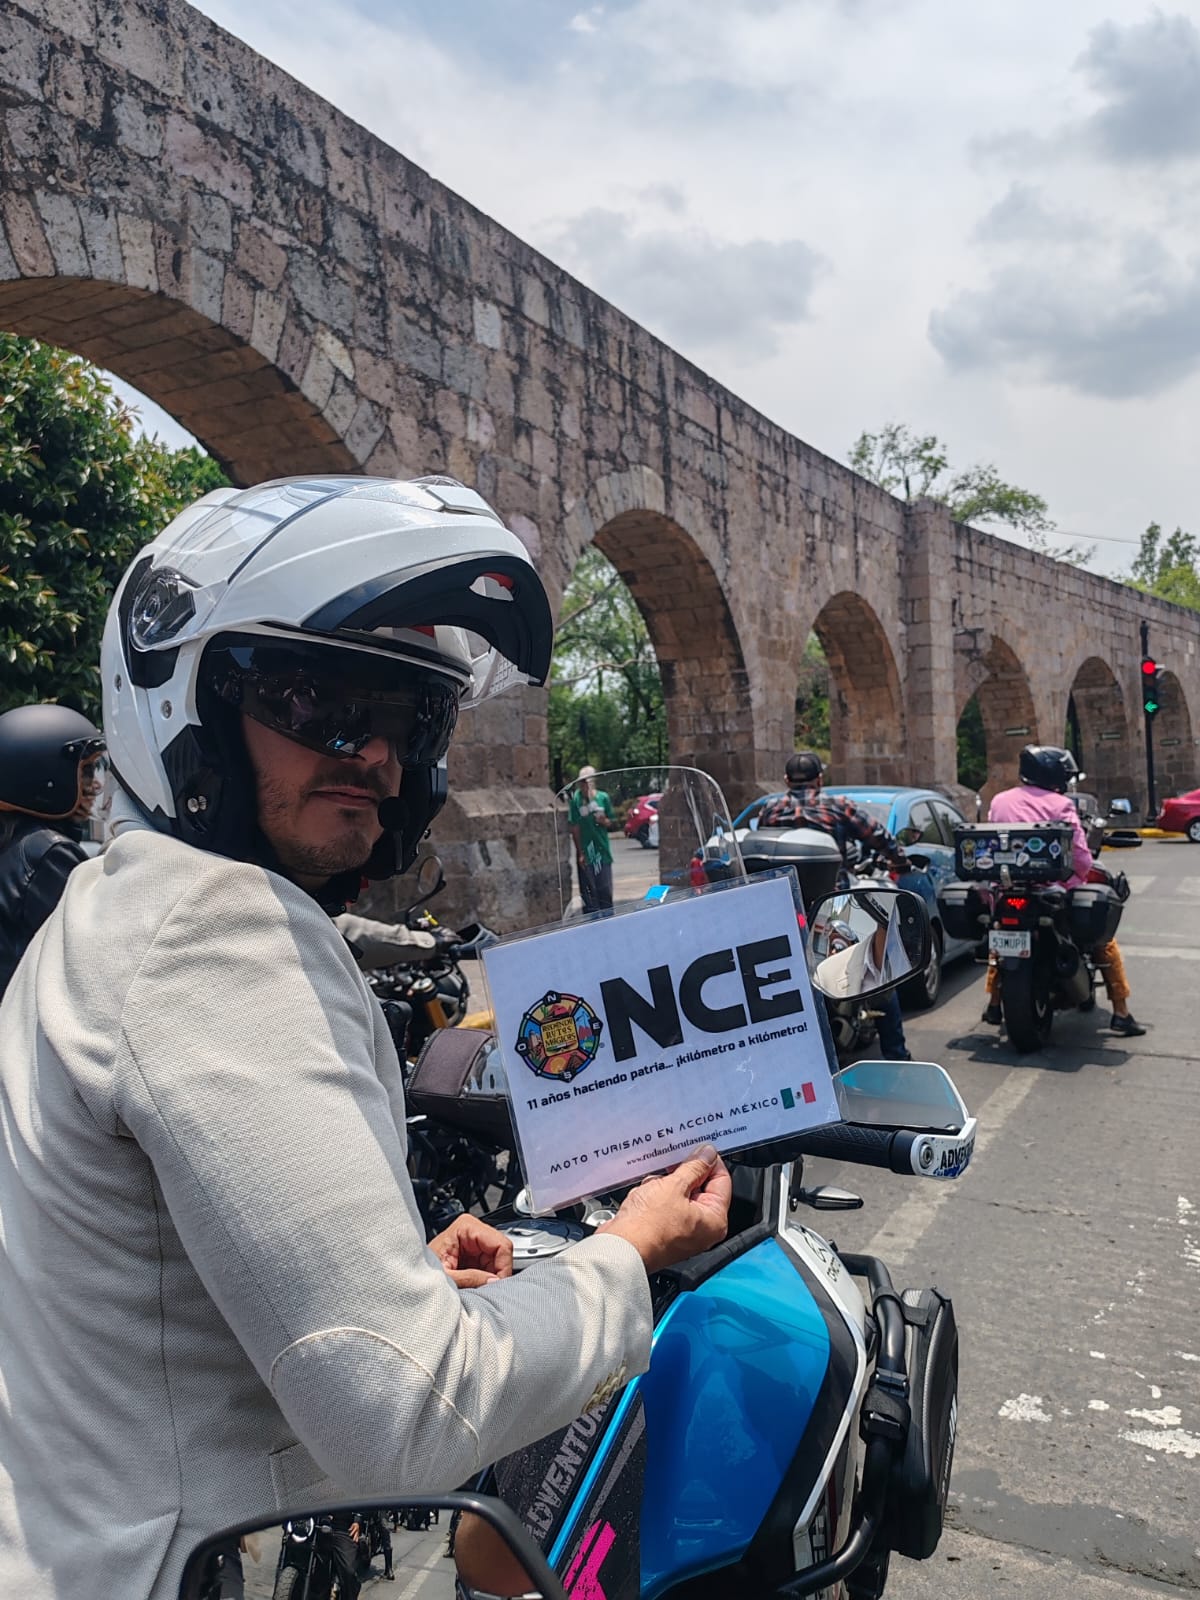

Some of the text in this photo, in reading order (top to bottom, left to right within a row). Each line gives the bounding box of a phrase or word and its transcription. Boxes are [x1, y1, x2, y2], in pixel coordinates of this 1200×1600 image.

[527, 1021, 809, 1110] 11 años haciendo patria... ¡kilómetro a kilómetro!
[550, 1097, 779, 1174] MOTO TURISMO EN ACCIÓN MÉXICO
[626, 1125, 748, 1165] www.rodandorutasmagicas.com
